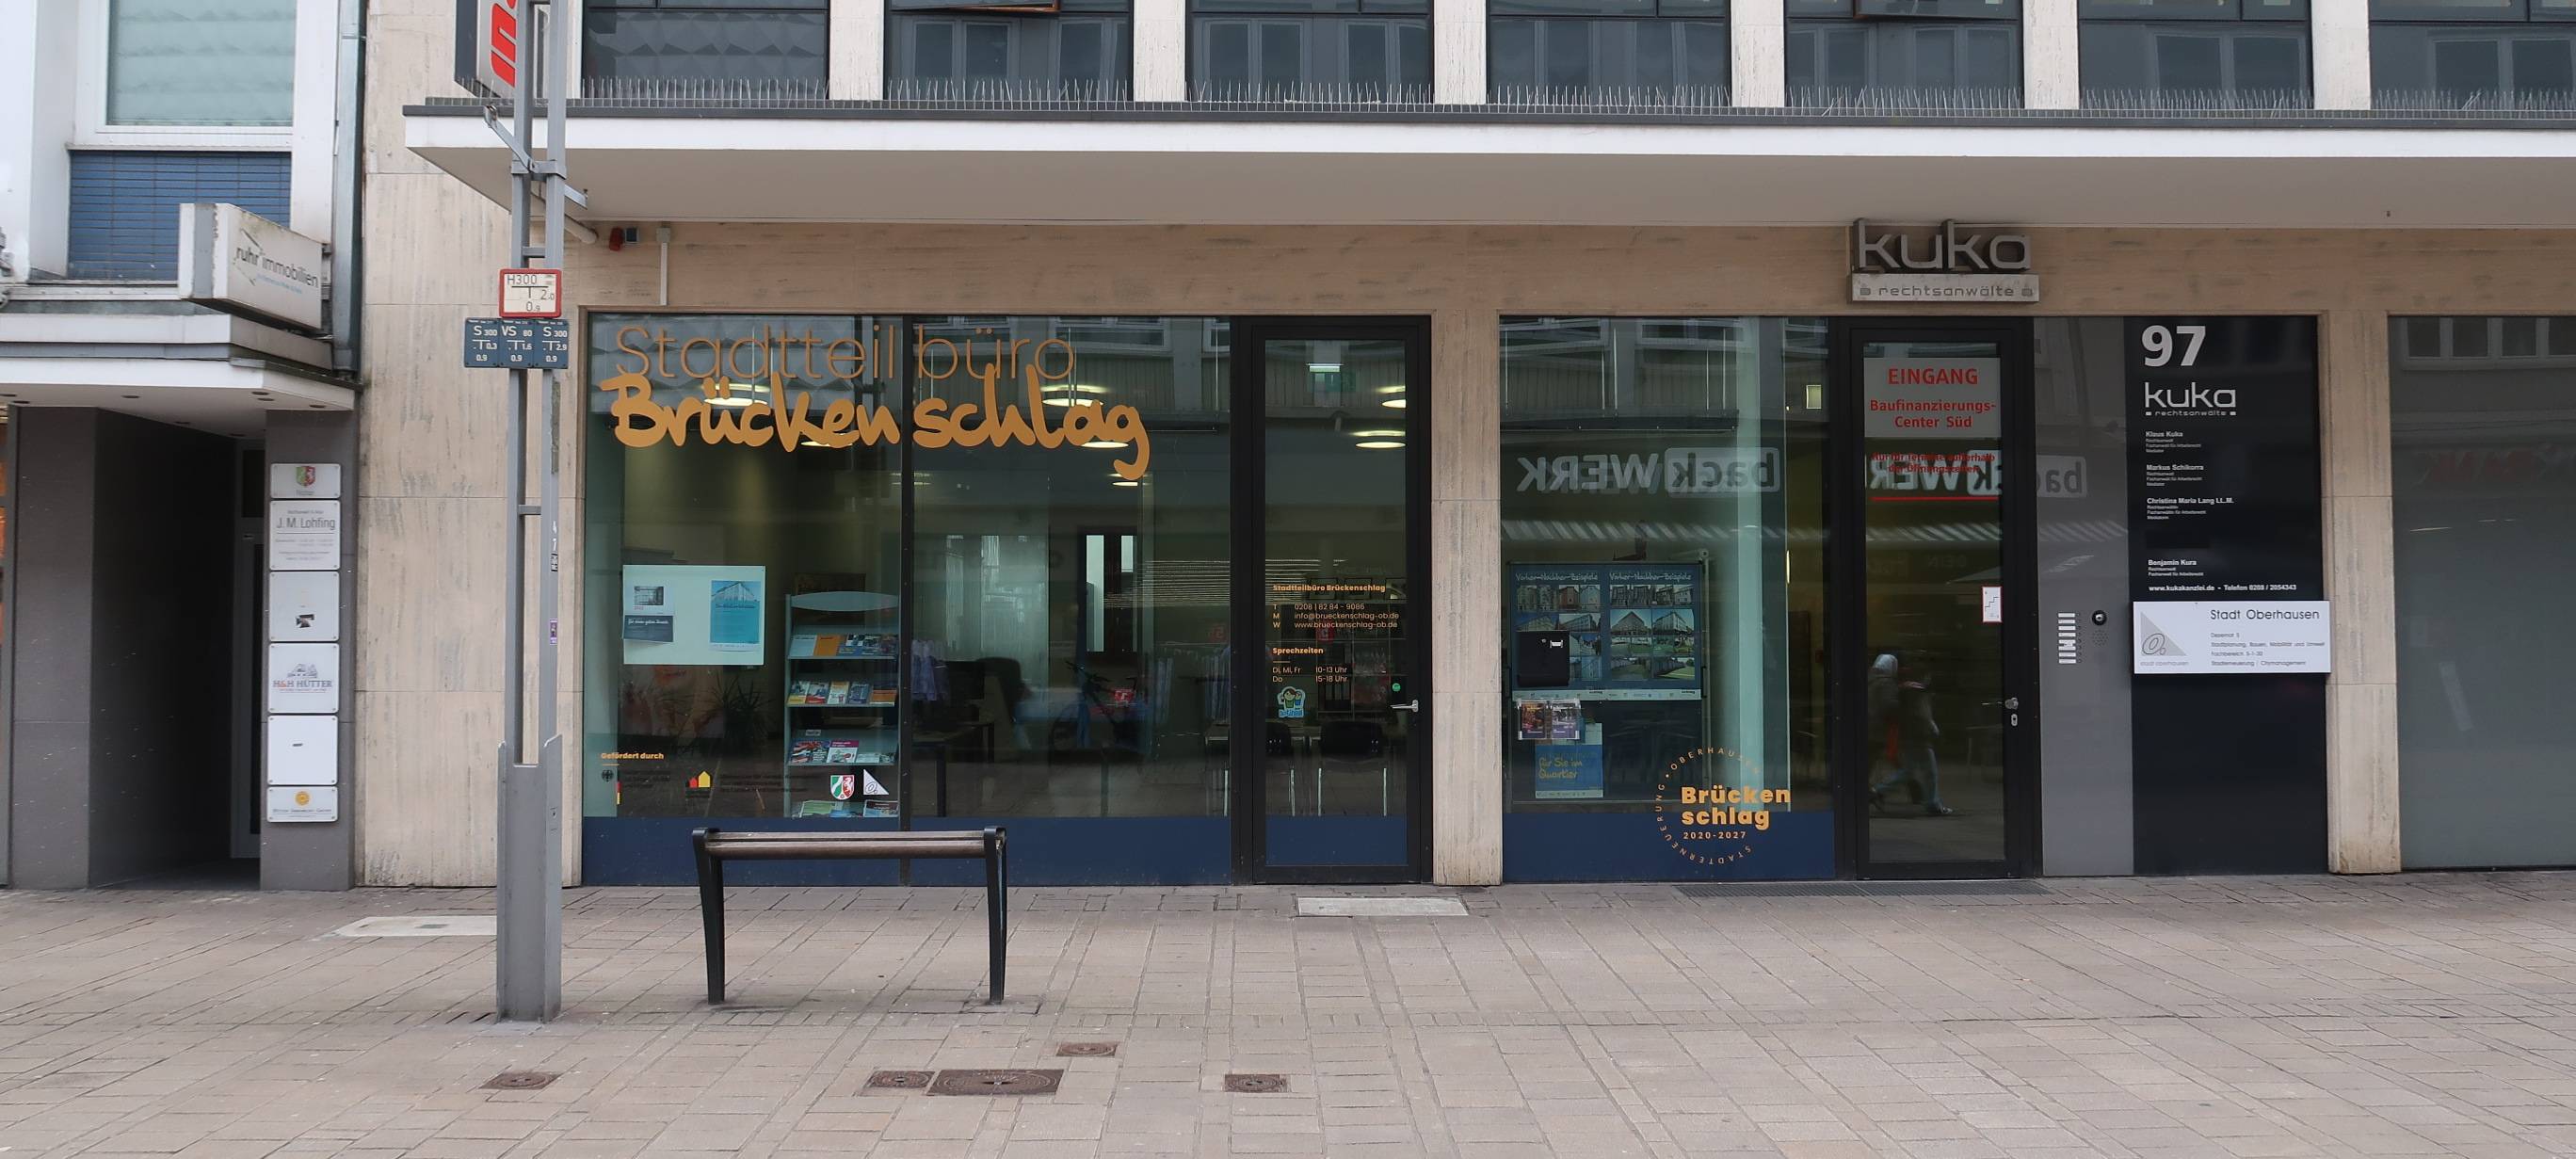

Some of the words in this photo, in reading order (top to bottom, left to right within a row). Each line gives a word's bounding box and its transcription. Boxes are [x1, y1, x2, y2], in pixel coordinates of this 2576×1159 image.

[1858, 219, 2031, 269] kuka
[236, 247, 259, 266] ruhr
[1878, 285, 2014, 297] rechtsanwälte
[474, 325, 482, 336] S
[501, 325, 517, 336] VS
[542, 326, 552, 337] S
[614, 324, 895, 379] Stadtteil
[917, 324, 1076, 380] büro
[2141, 325, 2207, 367] 97
[1888, 368, 1979, 385] EINGANG
[2144, 381, 2236, 408] kuka
[1870, 399, 1997, 413] Baufinanzierungs-
[600, 369, 901, 453] Brücken
[911, 362, 1151, 481] schlag
[1894, 416, 1940, 427] Center
[1946, 416, 1972, 427] Süd
[1294, 612, 1399, 620] info@brueckenschlag-ob.de
[2210, 609, 2241, 620] Stadt
[2246, 609, 2320, 620] Oberhausen
[1294, 621, 1398, 630] www.brueckenschlag-ob.de
[1272, 646, 1324, 655] Sprechzeiten
[1681, 784, 1791, 804] Brücken
[1682, 807, 1770, 830] schlag
[1682, 831, 1747, 840] 2020-2027
